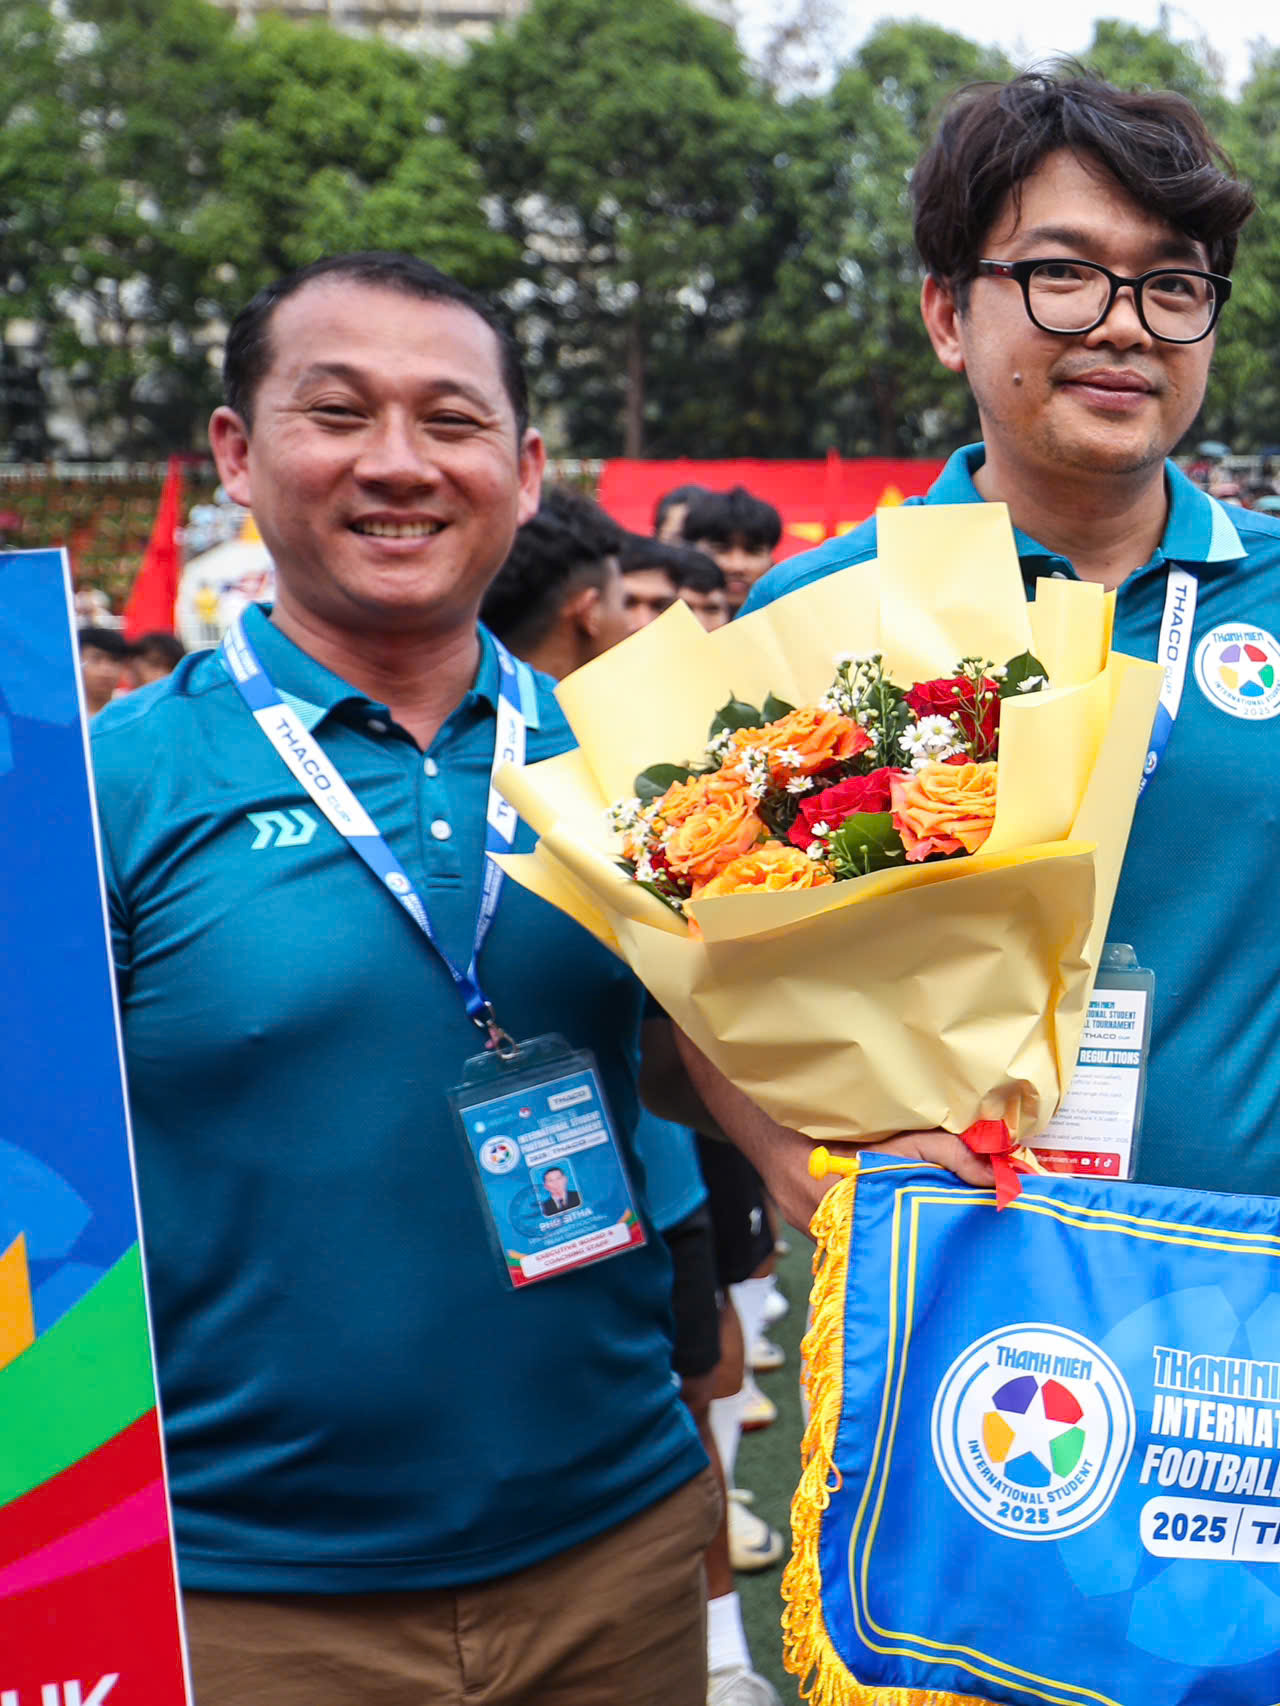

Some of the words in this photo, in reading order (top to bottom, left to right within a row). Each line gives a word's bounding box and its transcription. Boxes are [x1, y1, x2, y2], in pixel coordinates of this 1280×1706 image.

[1166, 585, 1187, 661] THACO
[1164, 665, 1174, 694] CUP
[1215, 681, 1264, 706] INTERNATIONAL
[1243, 707, 1271, 716] 2025
[276, 717, 332, 791] THACO
[1092, 1020, 1136, 1030] TOURNAMENT
[1109, 1010, 1136, 1019] STUDENT
[1080, 1050, 1140, 1064] REGULATIONS
[554, 1090, 586, 1104] THACO
[563, 1207, 593, 1224] SITHA
[535, 1242, 577, 1261] EXECUTIVE
[997, 1345, 1052, 1374] THANH
[1052, 1355, 1093, 1380] NIEN
[1153, 1345, 1249, 1399] THANH
[968, 1439, 1044, 1505] INTERNATIONAL
[1046, 1459, 1093, 1503] STUDENT
[996, 1501, 1050, 1524] 2025
[1152, 1511, 1228, 1544] 2025
